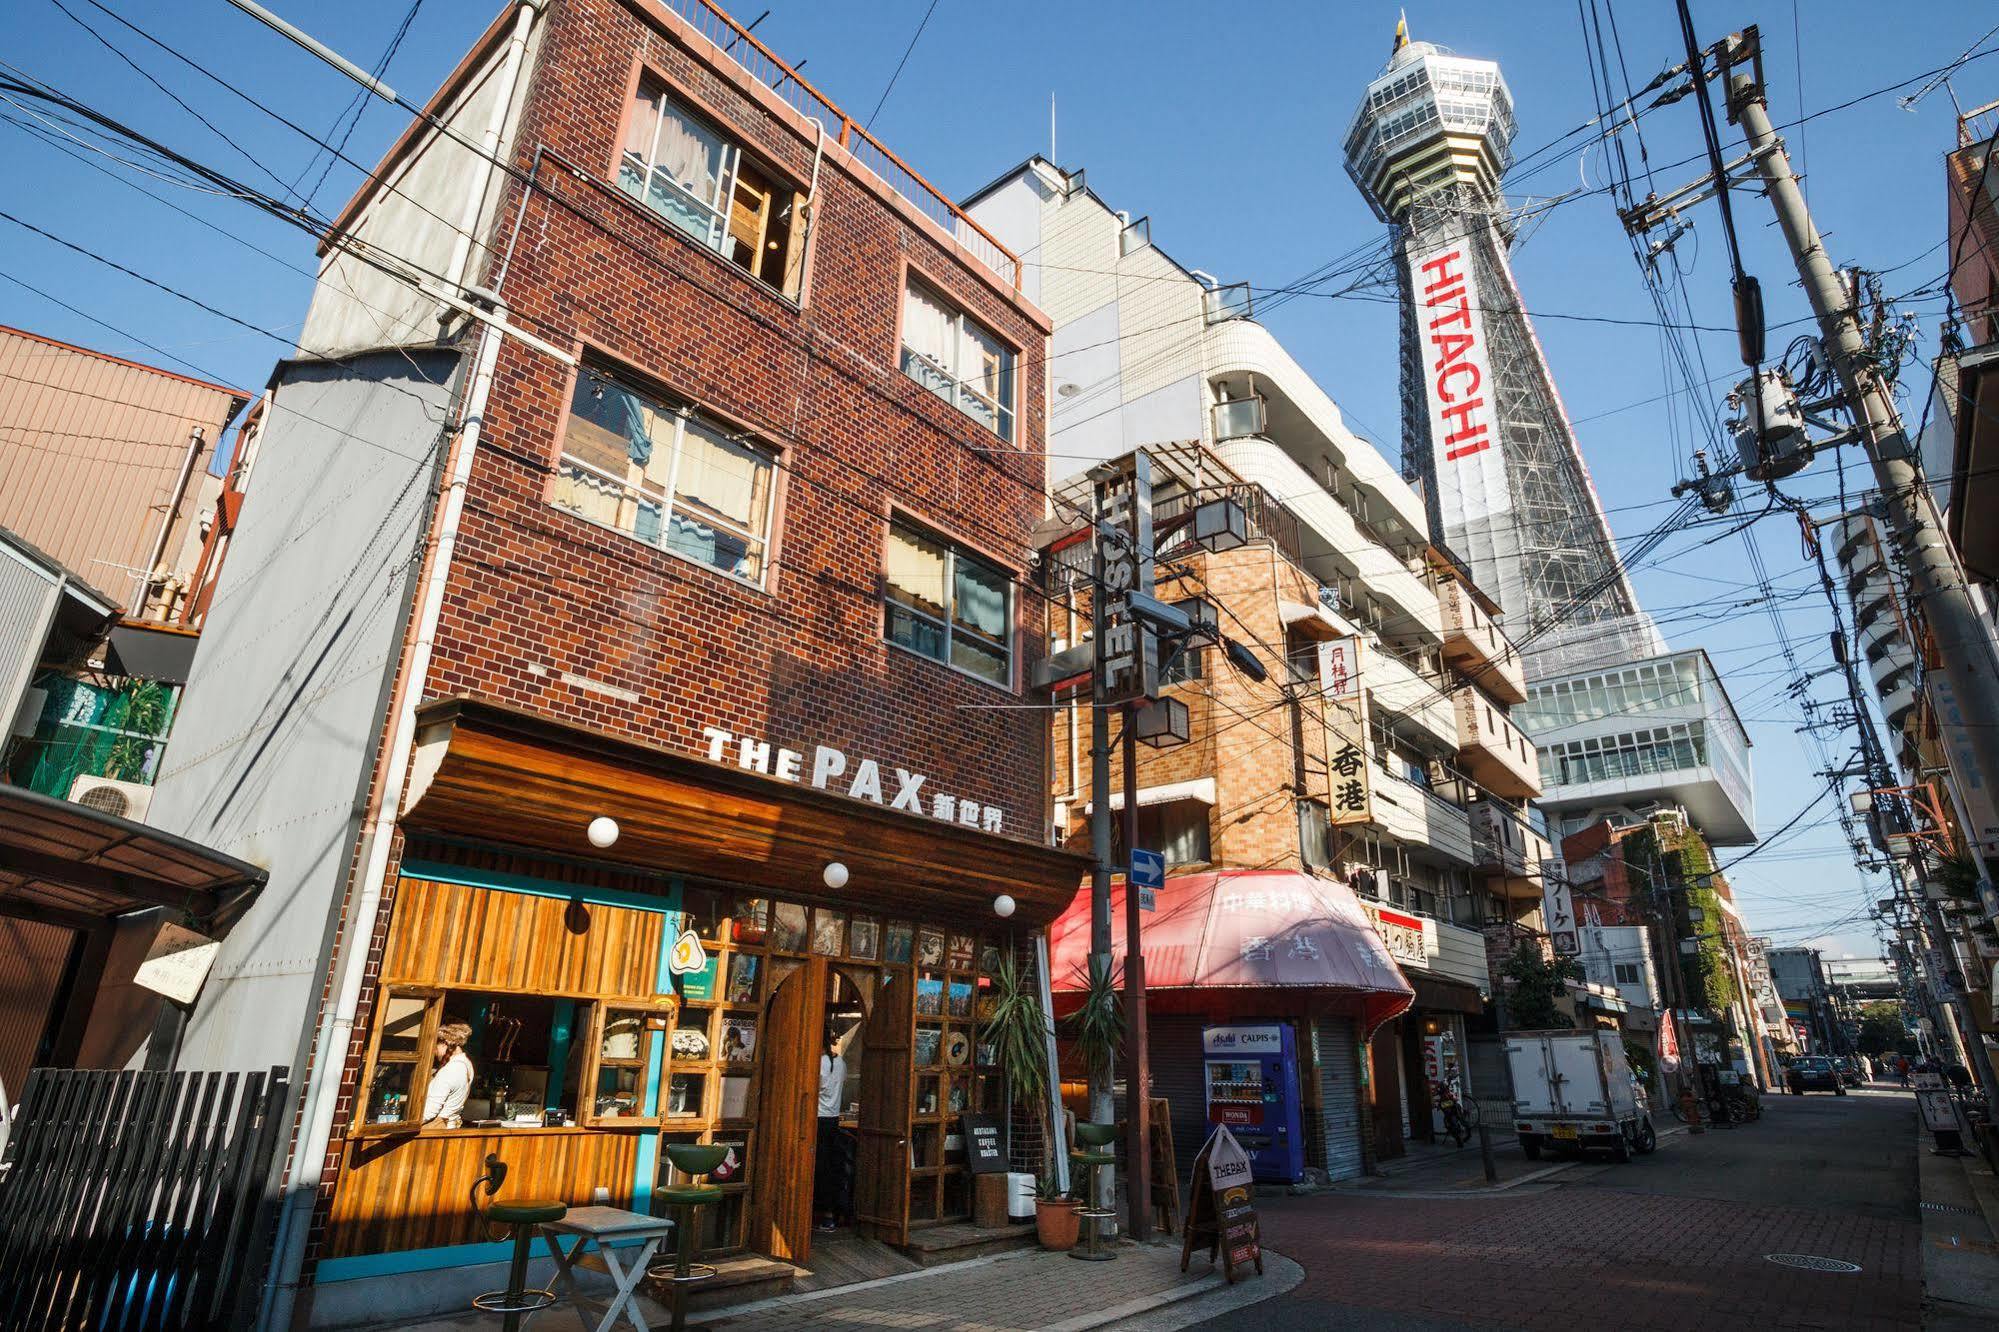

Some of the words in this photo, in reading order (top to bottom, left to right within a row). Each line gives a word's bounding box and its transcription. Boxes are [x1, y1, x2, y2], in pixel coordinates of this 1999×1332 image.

[1421, 250, 1490, 461] HITACHI
[703, 726, 803, 783] THE
[811, 745, 926, 815] PAX
[932, 792, 1003, 834] 新世界
[1331, 743, 1366, 812] 香港
[1241, 1032, 1269, 1044] CALPIS
